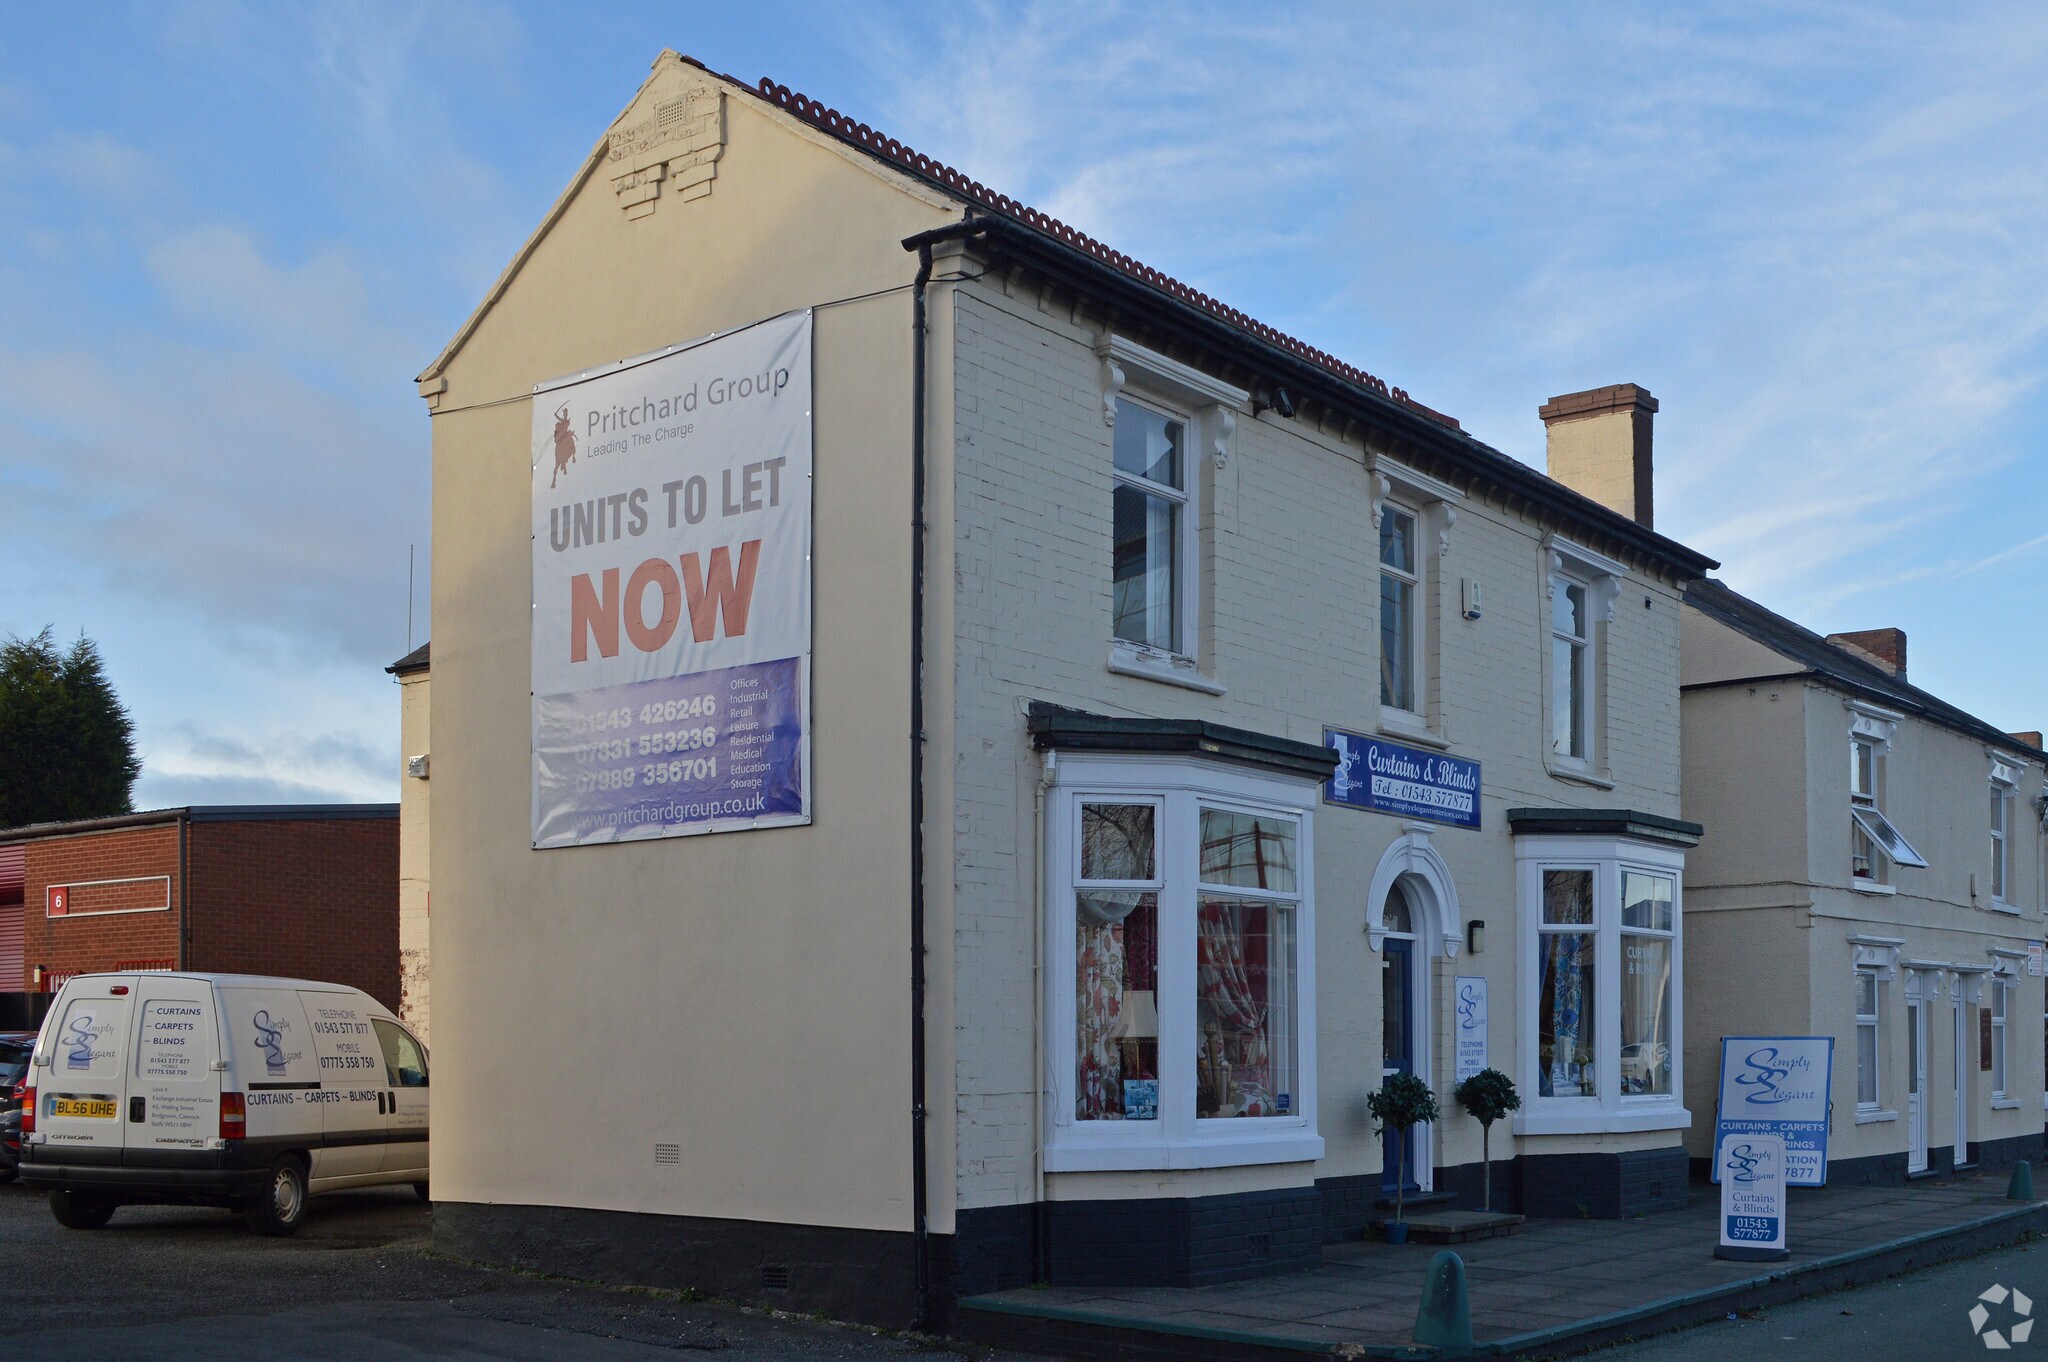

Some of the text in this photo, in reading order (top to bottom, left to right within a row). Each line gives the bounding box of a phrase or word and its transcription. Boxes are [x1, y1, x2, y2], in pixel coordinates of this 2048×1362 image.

[588, 367, 789, 437] Pritchard Group
[587, 423, 694, 458] Leading The Charge
[550, 456, 786, 552] UNITS TO LET
[571, 539, 762, 663] NOW
[730, 679, 758, 690] Offices
[730, 690, 768, 704] Industrial
[640, 694, 716, 725] 426246
[730, 706, 753, 718] Retail
[730, 721, 758, 733] Leisure
[639, 726, 716, 755] 553236
[730, 731, 774, 746] Residential
[730, 747, 762, 761] Medical
[643, 757, 717, 785] 356701
[730, 763, 771, 775] Education
[1368, 745, 1476, 790] Curtains & Blinds
[730, 778, 762, 789] Storage
[1401, 784, 1432, 802] 01543
[1434, 791, 1471, 809] 577877
[55, 895, 62, 908] 6
[318, 1009, 356, 1019] TELEPHONE
[155, 1022, 194, 1030] CARPETS
[315, 1022, 368, 1034] 01543 577 877
[153, 1037, 185, 1045] BLINDS
[336, 1043, 360, 1053] MOBILE
[320, 1057, 374, 1068] 07775 558 750
[1735, 1047, 1810, 1084] Simply
[1745, 1069, 1815, 1104] Elegant
[247, 1093, 294, 1105] CURTAINS
[305, 1092, 340, 1103] CARPETS
[349, 1090, 376, 1101] BLINDS
[57, 1102, 114, 1115] BL56 UHE
[1721, 1122, 1771, 1130] CURTAINS
[1780, 1123, 1825, 1131] CARPETS
[1727, 1144, 1771, 1168] Simply
[1733, 1159, 1774, 1182] Elegant
[1732, 1192, 1774, 1202] Curtains
[1732, 1203, 1774, 1213] & Blinds
[1737, 1218, 1768, 1229] 01543
[1733, 1228, 1771, 1239] 577877
